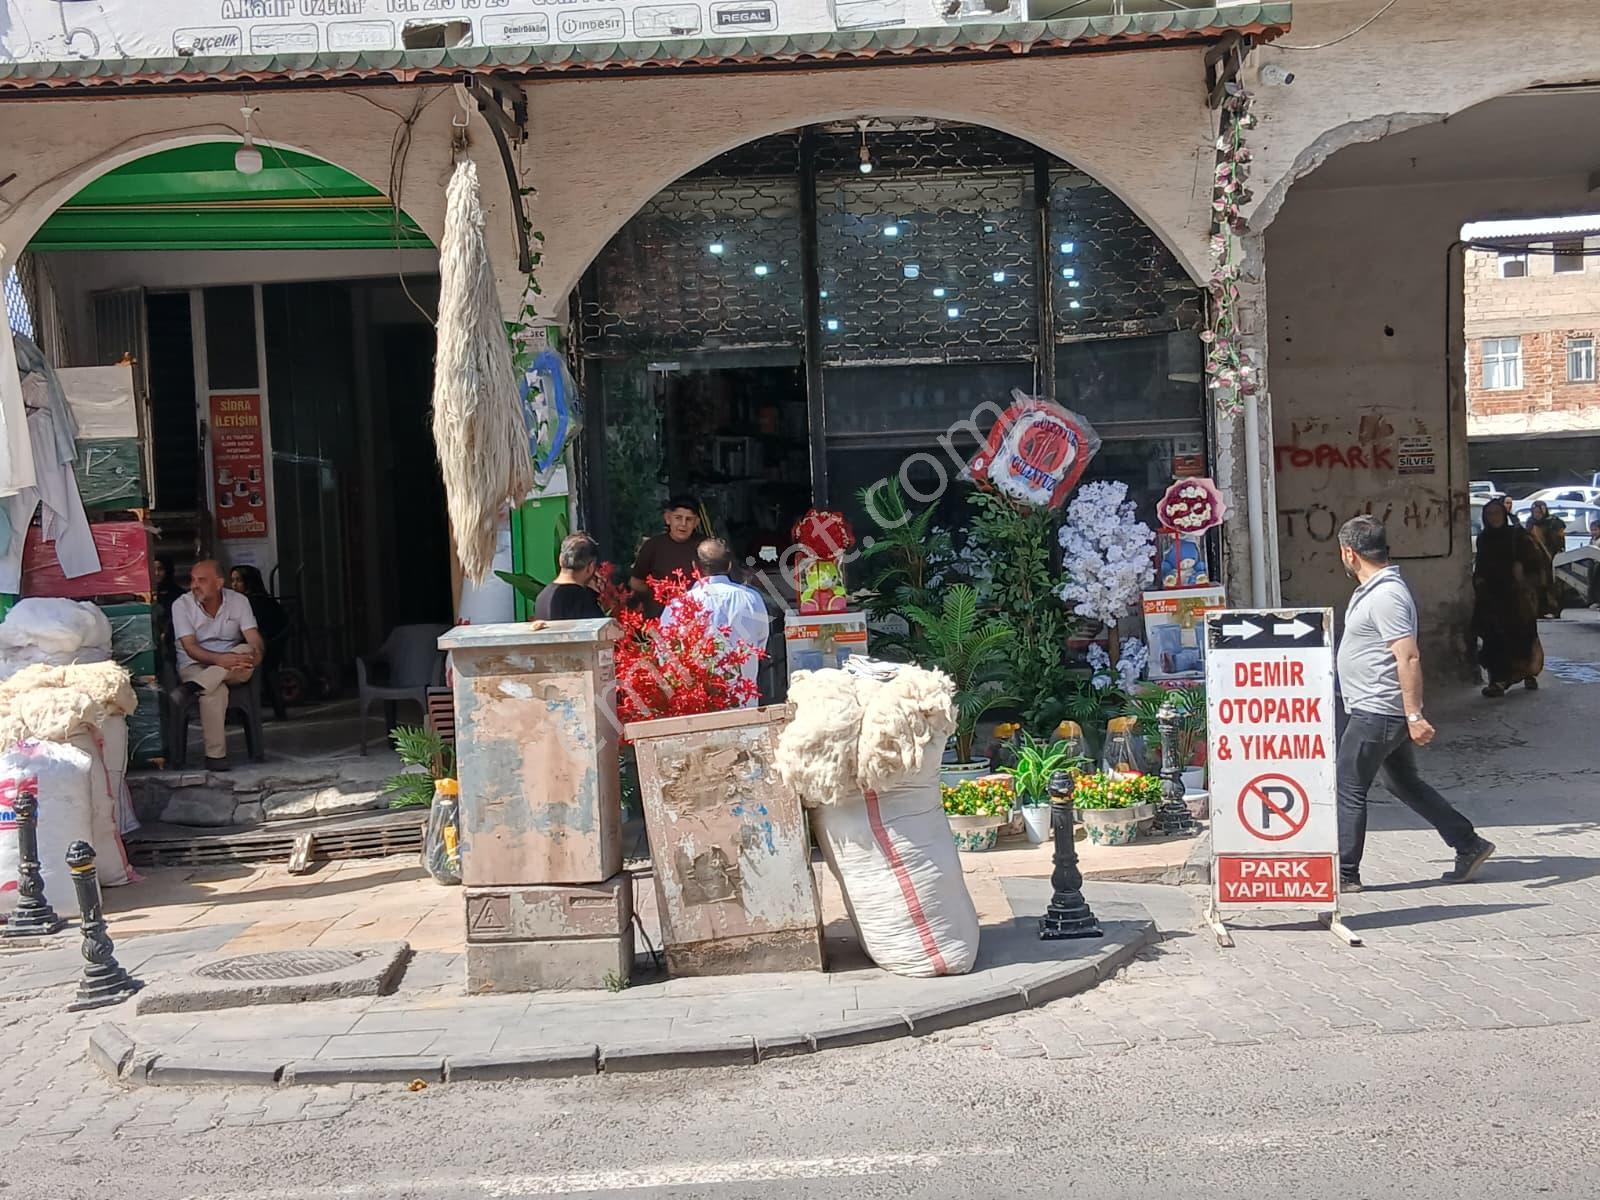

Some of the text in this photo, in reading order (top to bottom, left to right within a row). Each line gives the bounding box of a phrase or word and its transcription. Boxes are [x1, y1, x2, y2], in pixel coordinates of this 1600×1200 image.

[721, 12, 766, 24] REGAL
[215, 414, 258, 428] İLETİŞİM
[1234, 655, 1304, 687] DEMİR
[1218, 697, 1322, 725] OTOPARK
[1217, 734, 1326, 760] & YIKAMA
[1240, 861, 1310, 878] PARK
[1225, 881, 1329, 898] YAPILMAZ
